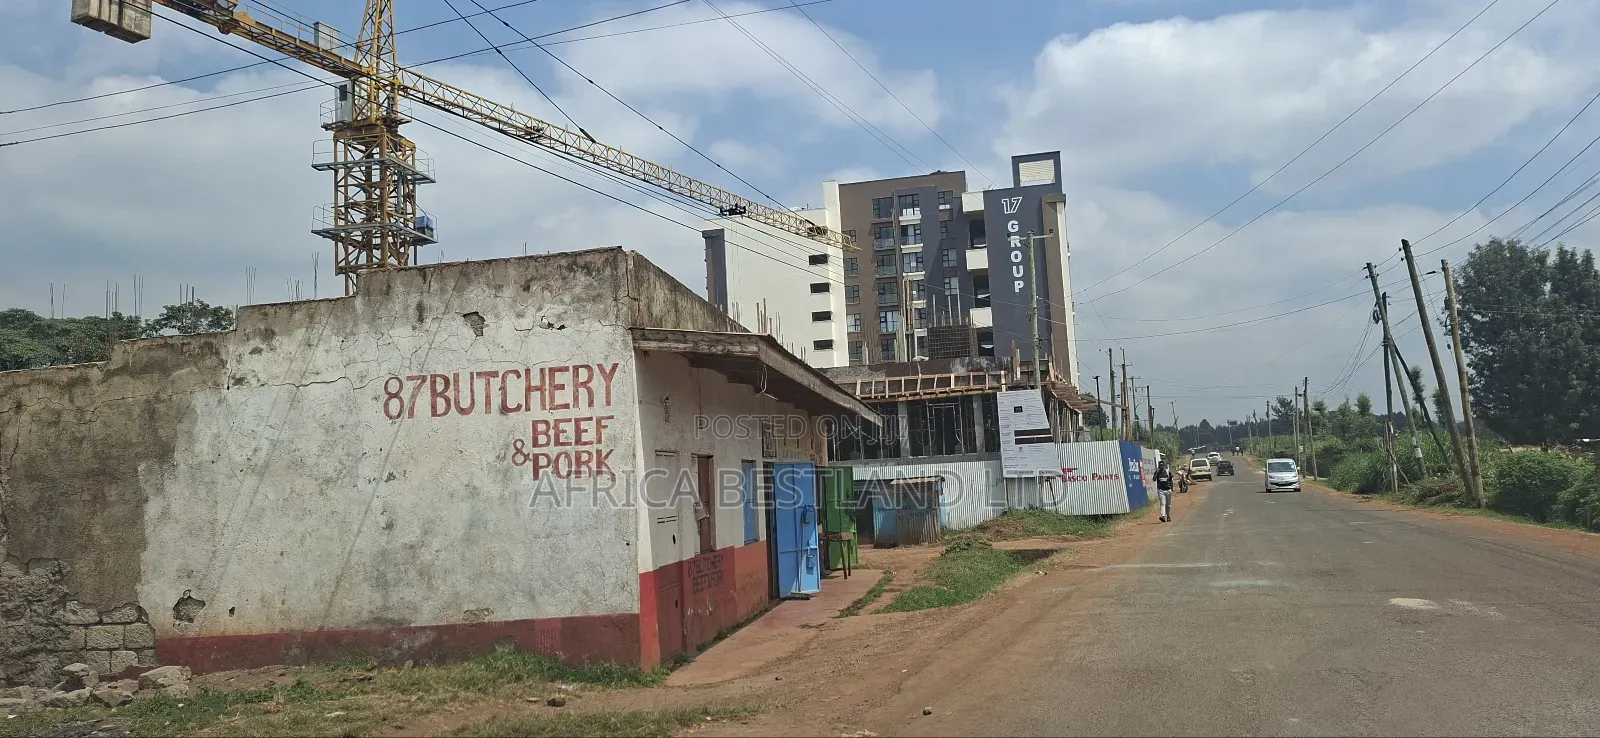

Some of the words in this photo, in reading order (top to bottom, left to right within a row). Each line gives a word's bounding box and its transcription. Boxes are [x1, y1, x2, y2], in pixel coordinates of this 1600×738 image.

[1002, 196, 1023, 214] 17
[1007, 220, 1024, 293] GROUP
[531, 415, 615, 448] BEEF
[511, 438, 532, 467] &
[532, 448, 616, 481] PORK
